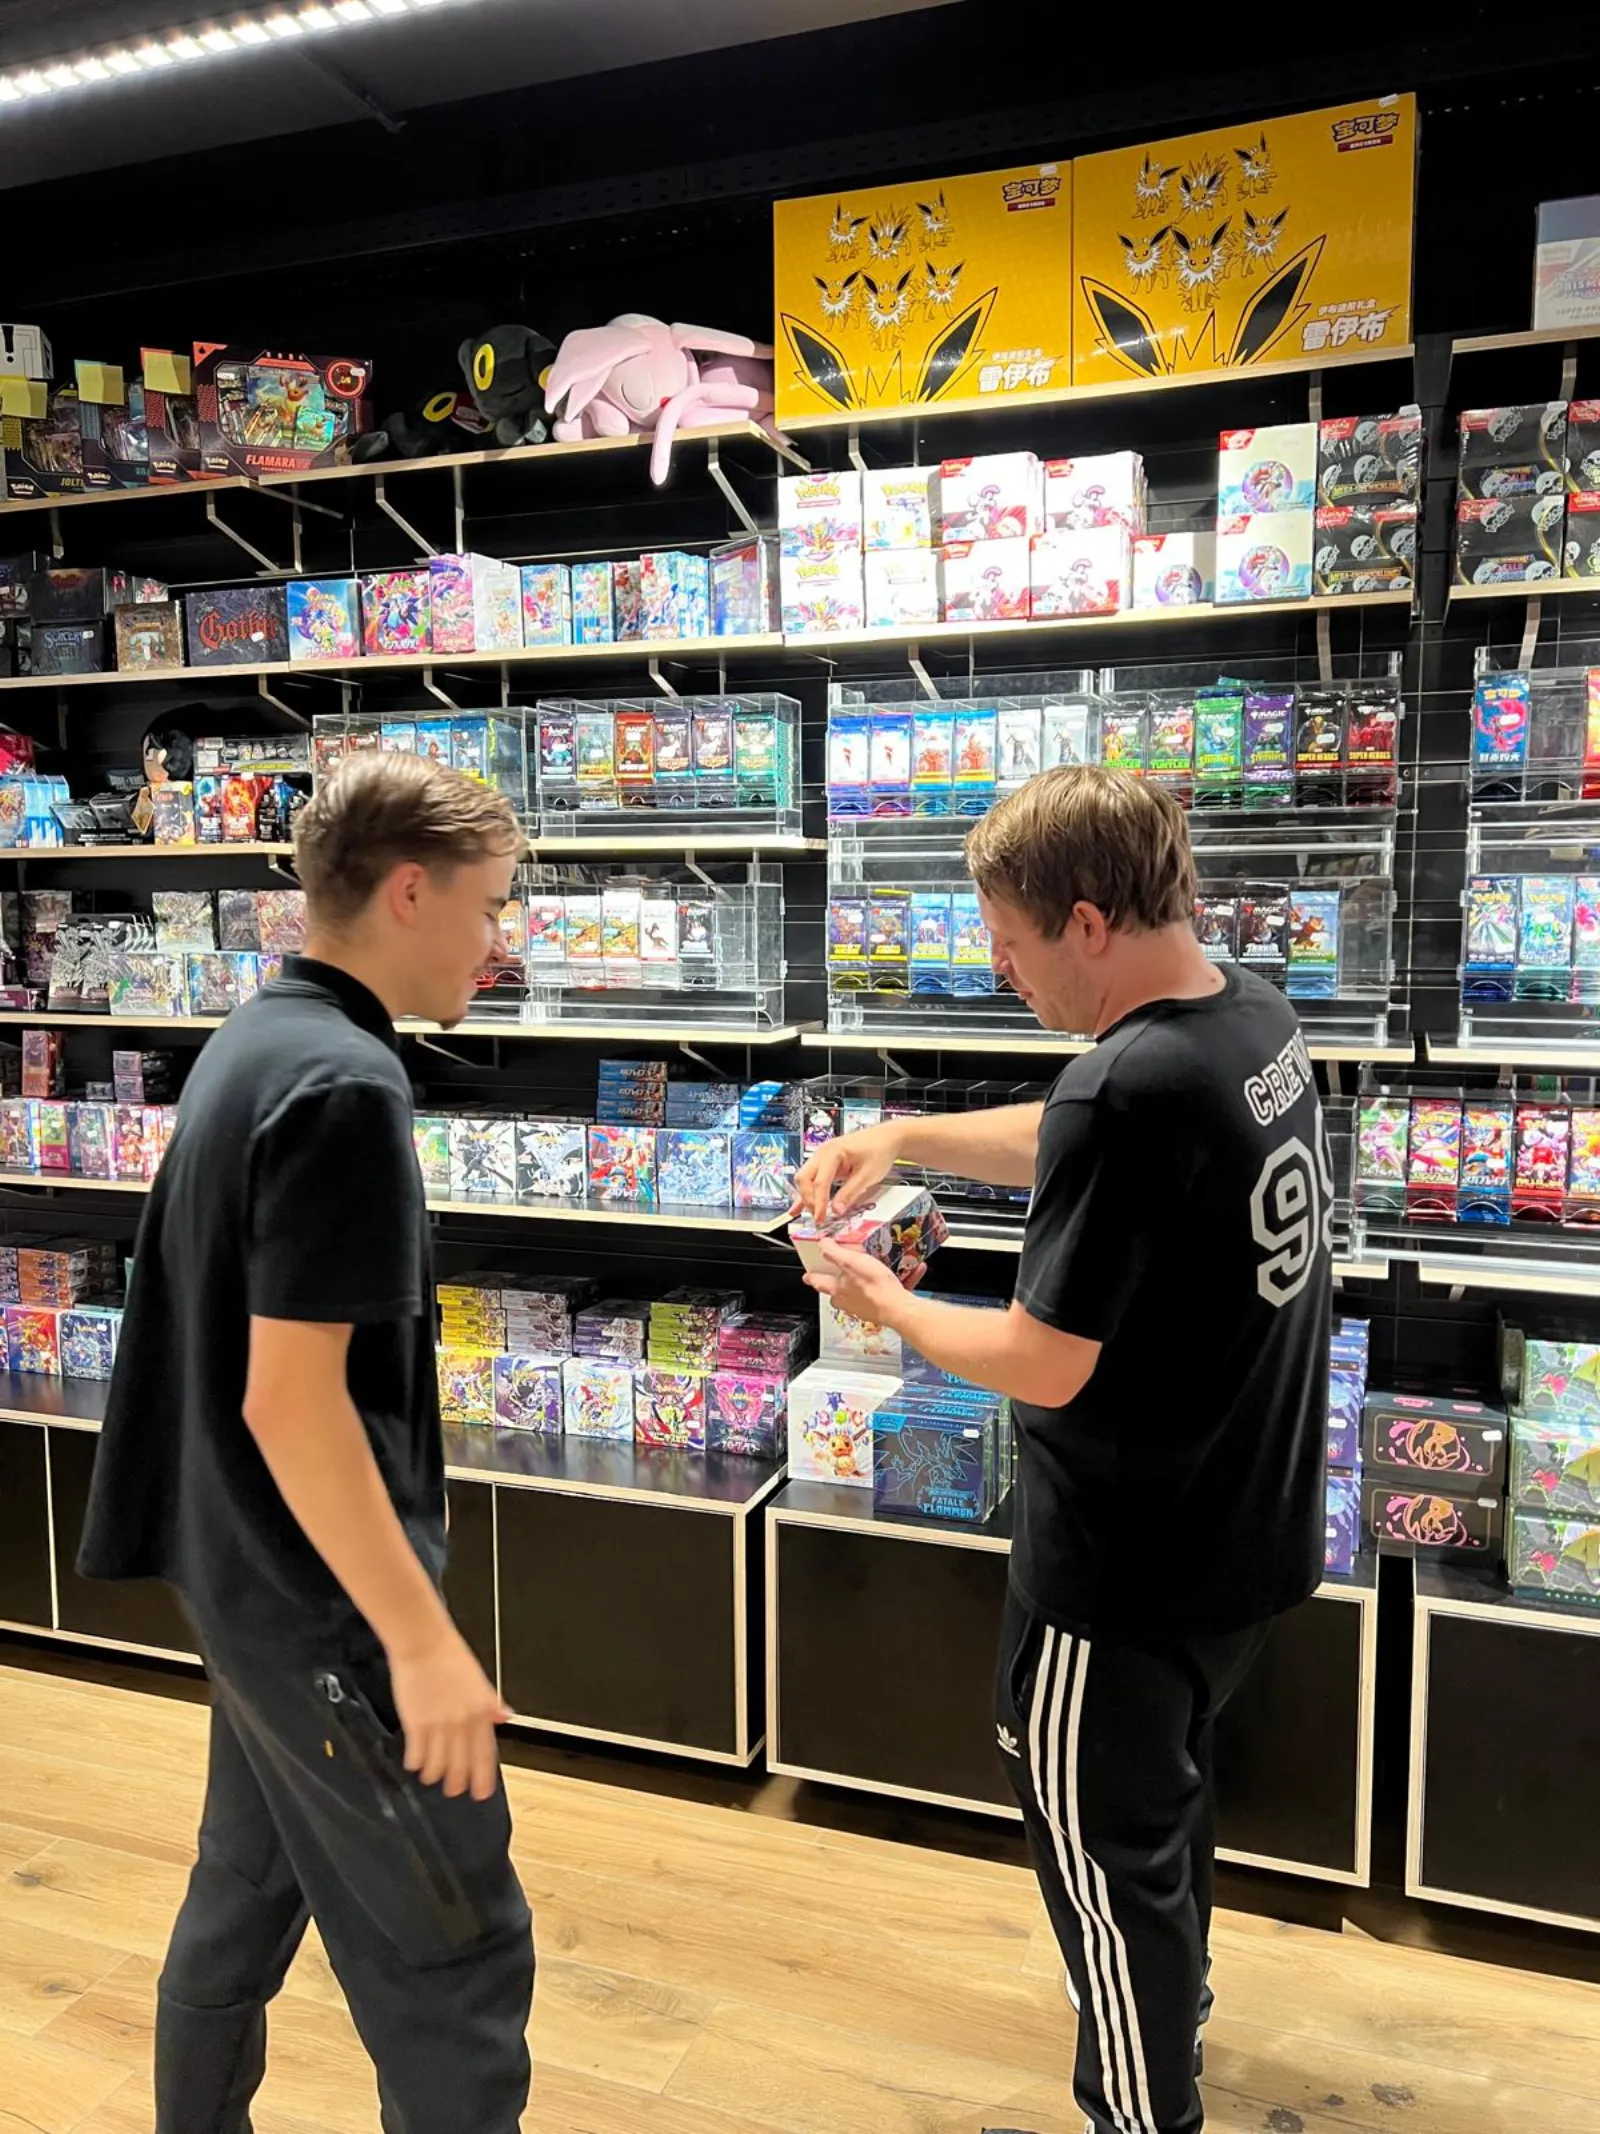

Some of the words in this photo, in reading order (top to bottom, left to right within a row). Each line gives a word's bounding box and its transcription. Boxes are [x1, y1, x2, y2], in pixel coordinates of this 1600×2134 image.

[246, 454, 296, 468] FLAMARA
[1253, 906, 1281, 915] MAGIC
[932, 1496, 963, 1507] FATALE
